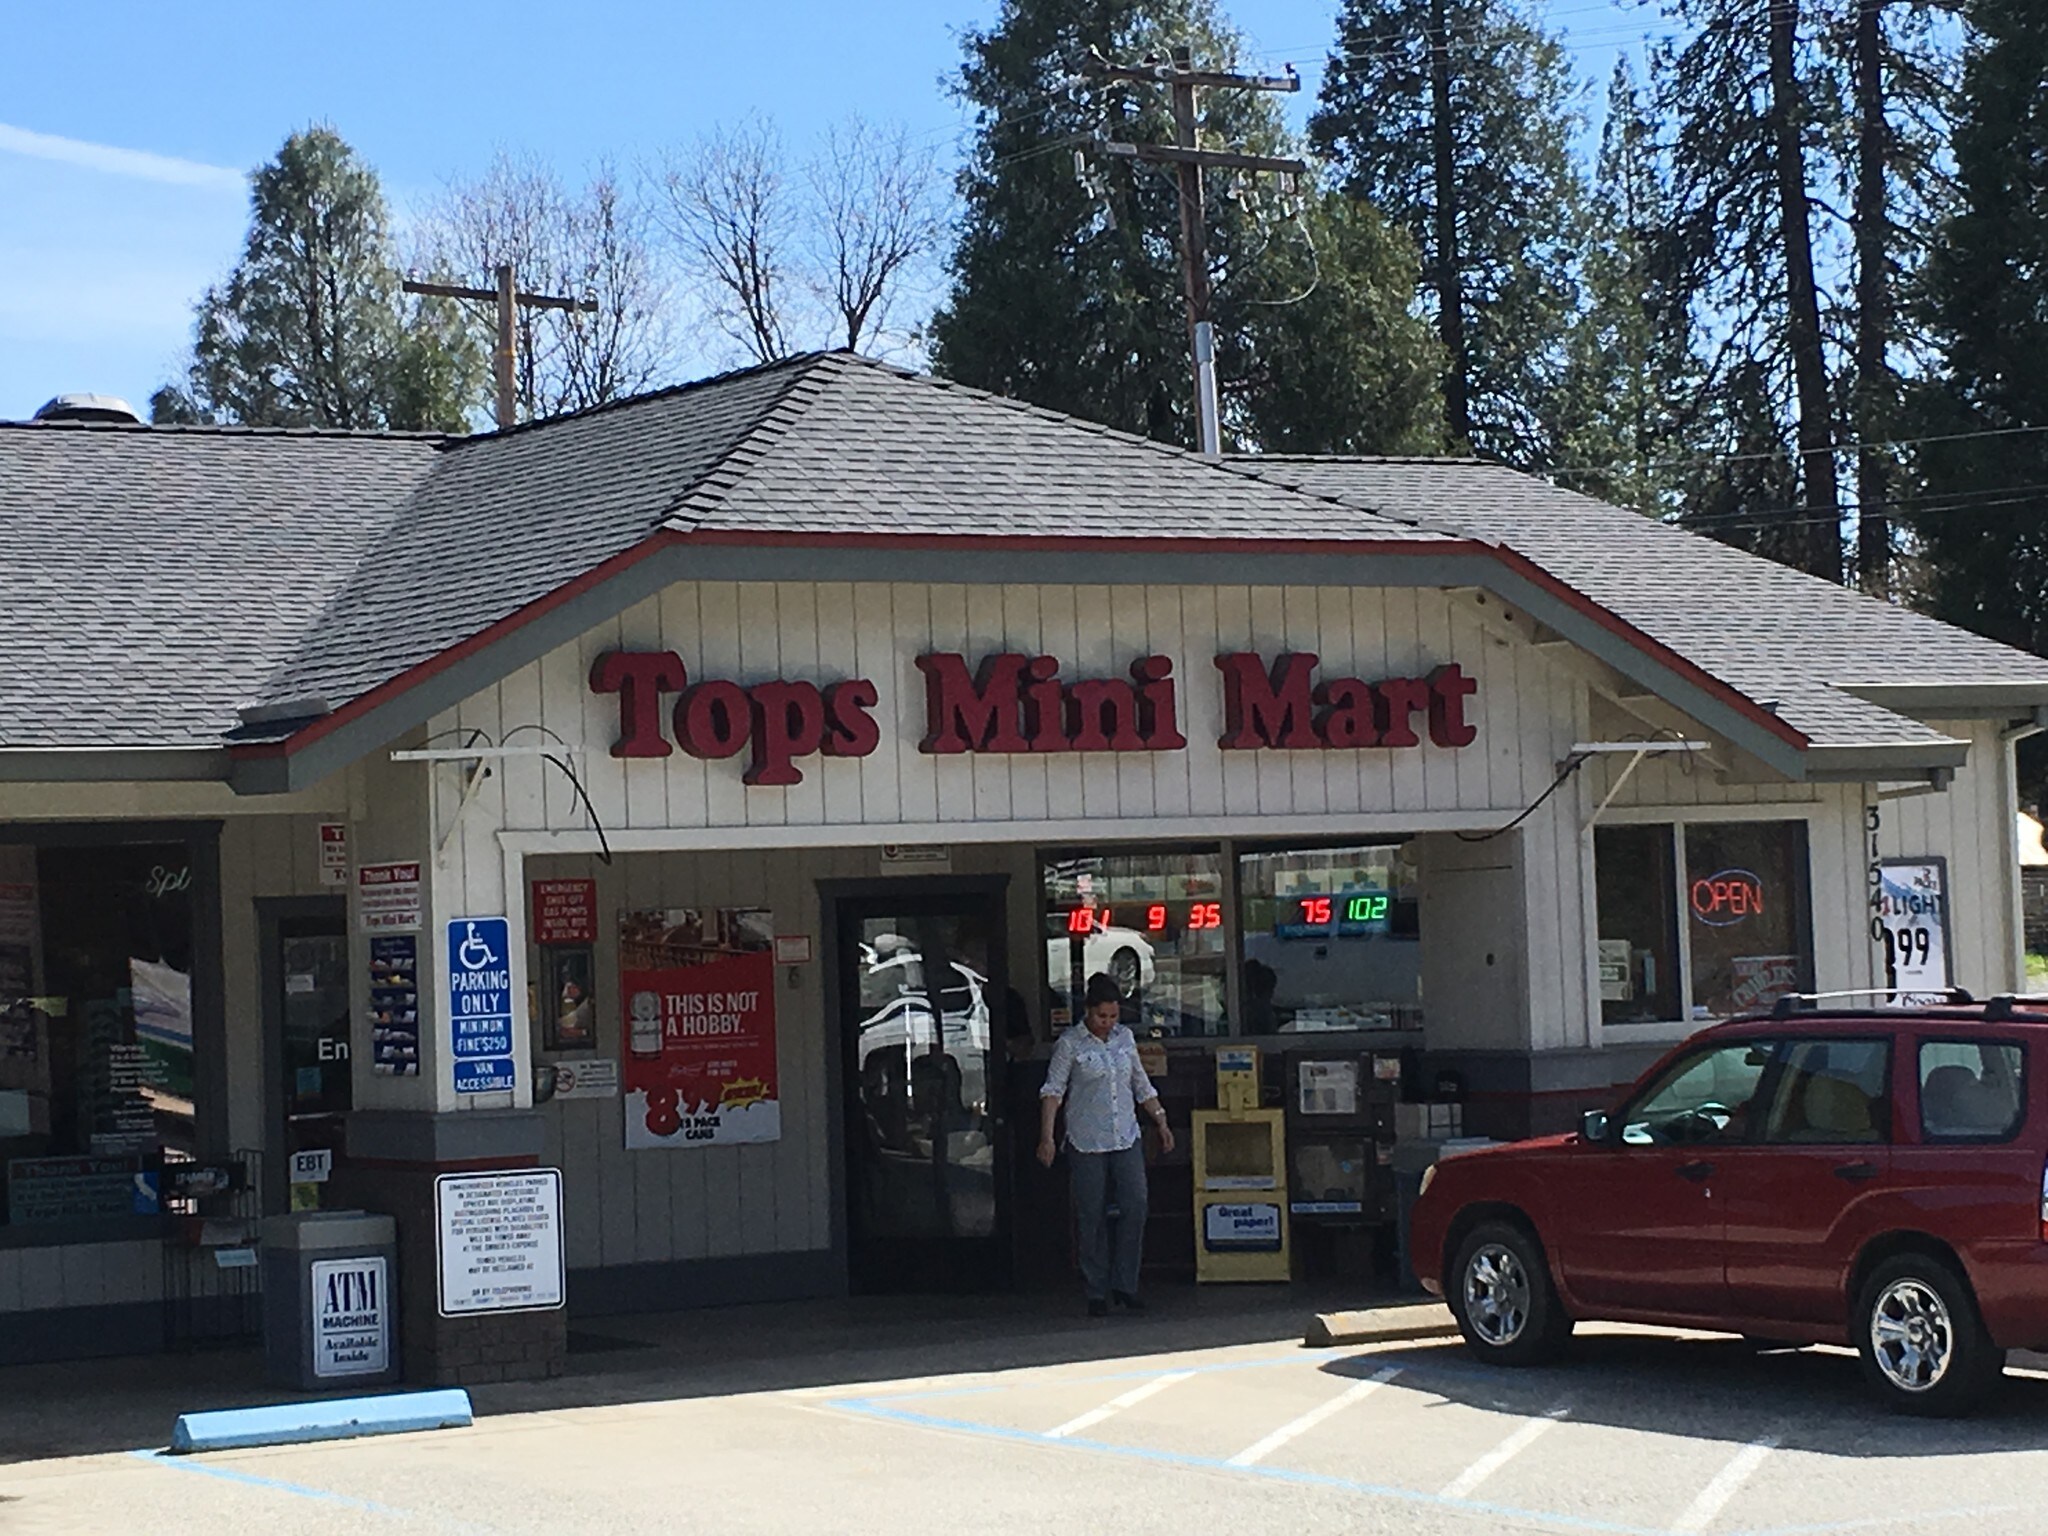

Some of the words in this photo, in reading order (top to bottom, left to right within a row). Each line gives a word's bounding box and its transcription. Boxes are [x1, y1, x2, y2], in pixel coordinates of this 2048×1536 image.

[591, 651, 879, 785] Tops
[916, 653, 1186, 753] Mini
[1214, 653, 1477, 749] Mart
[1867, 806, 1883, 941] 31540
[1693, 880, 1762, 914] OPEN
[1301, 898, 1330, 923] 75
[1349, 897, 1387, 920] 102
[452, 970, 508, 991] PARKING
[461, 993, 499, 1014] ONLY
[665, 993, 704, 1015] THIS
[707, 992, 723, 1013] IS
[727, 991, 759, 1012] NOT
[460, 1019, 503, 1033] MINIMUM
[666, 1016, 678, 1036] A
[683, 1013, 745, 1035] HOBBY.
[457, 1039, 480, 1051] FINE
[483, 1036, 506, 1051] $250
[474, 1062, 493, 1074] VAN
[456, 1075, 512, 1090] ACCESSIBLE
[297, 1154, 324, 1171] EBT
[1219, 1206, 1252, 1216] Great
[1234, 1216, 1273, 1228] paper!
[324, 1270, 376, 1313] ATM
[323, 1314, 378, 1328] MACHINE
[325, 1336, 378, 1349] Available
[334, 1350, 368, 1362] Inside
